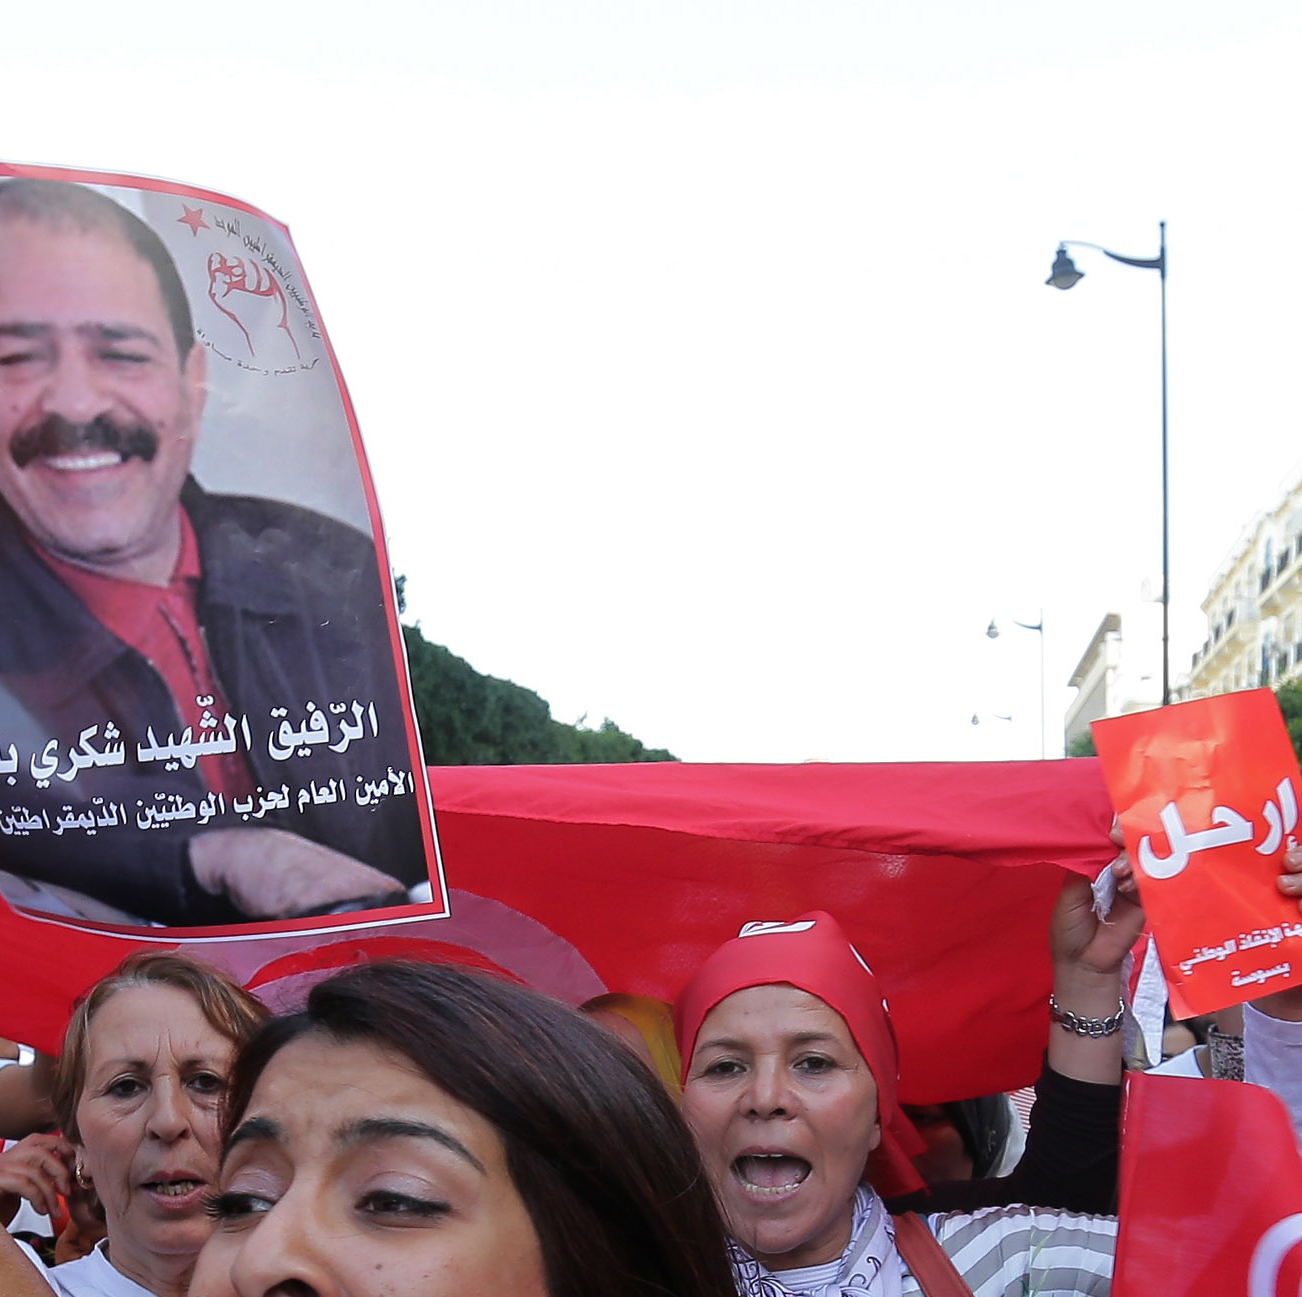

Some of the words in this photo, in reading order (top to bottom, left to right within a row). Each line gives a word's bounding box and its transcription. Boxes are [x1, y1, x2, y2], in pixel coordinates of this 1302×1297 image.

[29, 720, 126, 790] شكري
[232, 783, 291, 821] لحزب
[297, 778, 347, 813] العام
